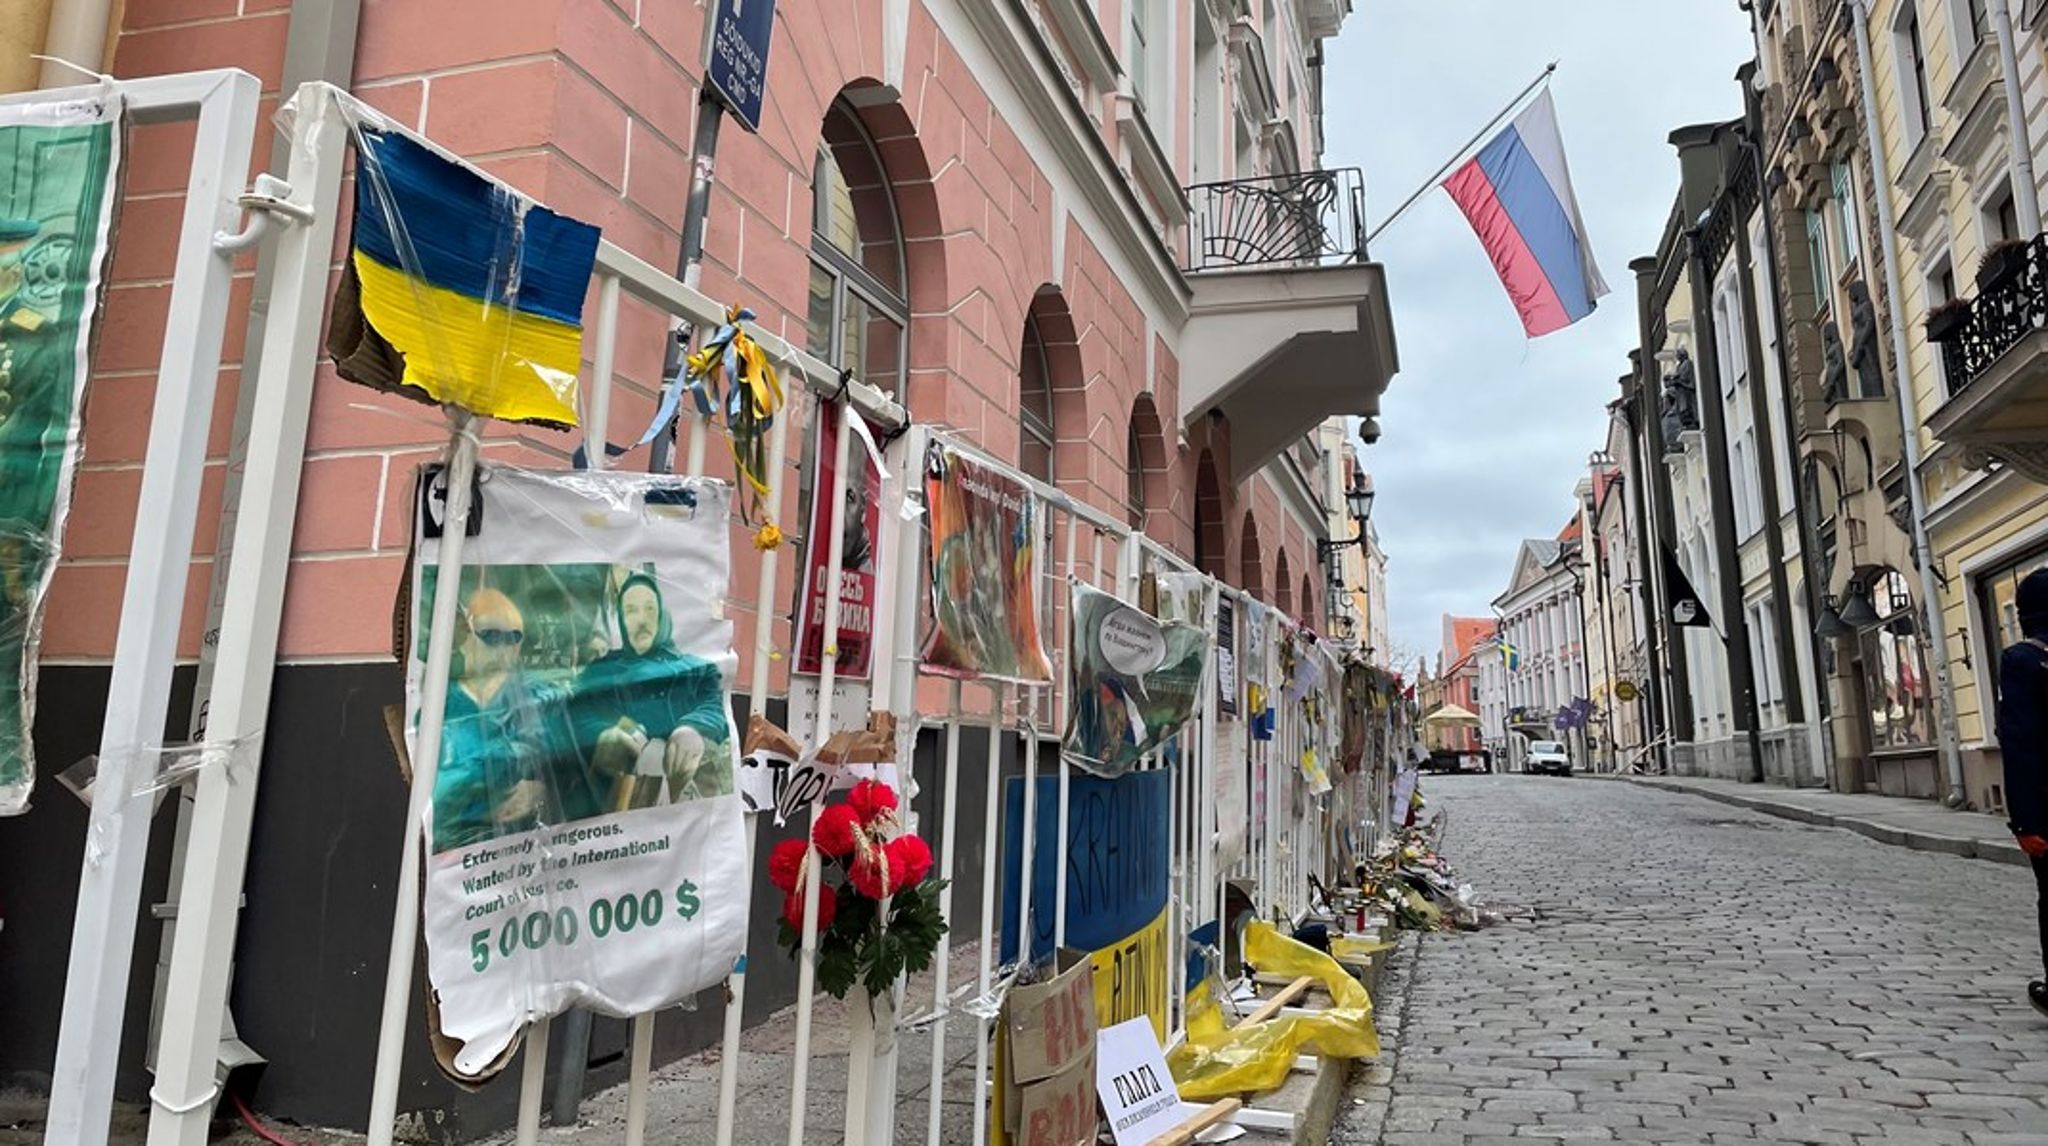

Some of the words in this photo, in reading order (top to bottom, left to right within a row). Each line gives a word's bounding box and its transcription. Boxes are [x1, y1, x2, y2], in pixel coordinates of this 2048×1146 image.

[716, 33, 734, 66] REG
[816, 565, 864, 601] ОЕСЬ
[537, 823, 623, 850] ngerous.
[462, 864, 516, 896] Wanted
[517, 860, 536, 879] by
[540, 857, 568, 872] te
[571, 834, 670, 868] International
[464, 893, 505, 921] Court
[588, 888, 664, 939] 000
[675, 878, 701, 921] $
